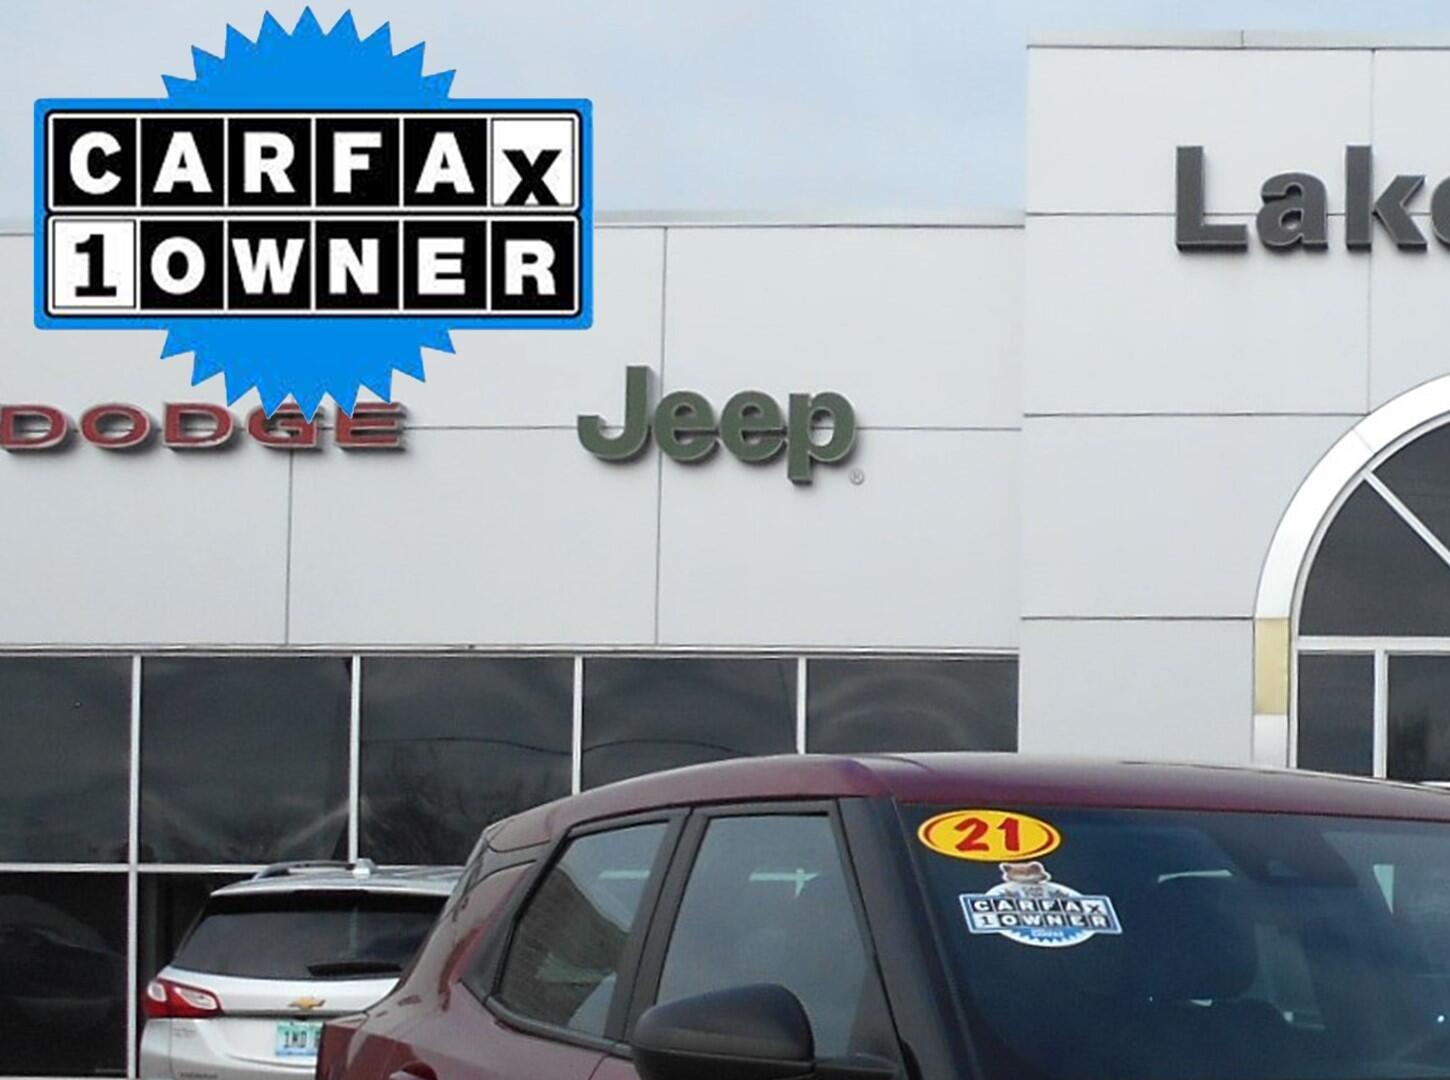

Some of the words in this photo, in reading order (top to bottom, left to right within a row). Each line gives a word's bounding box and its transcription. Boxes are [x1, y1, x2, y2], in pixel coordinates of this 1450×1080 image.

[0, 402, 408, 452] DODGE
[577, 365, 856, 485] Jeep
[954, 817, 1021, 852] 21
[972, 898, 1101, 913] CARFAX
